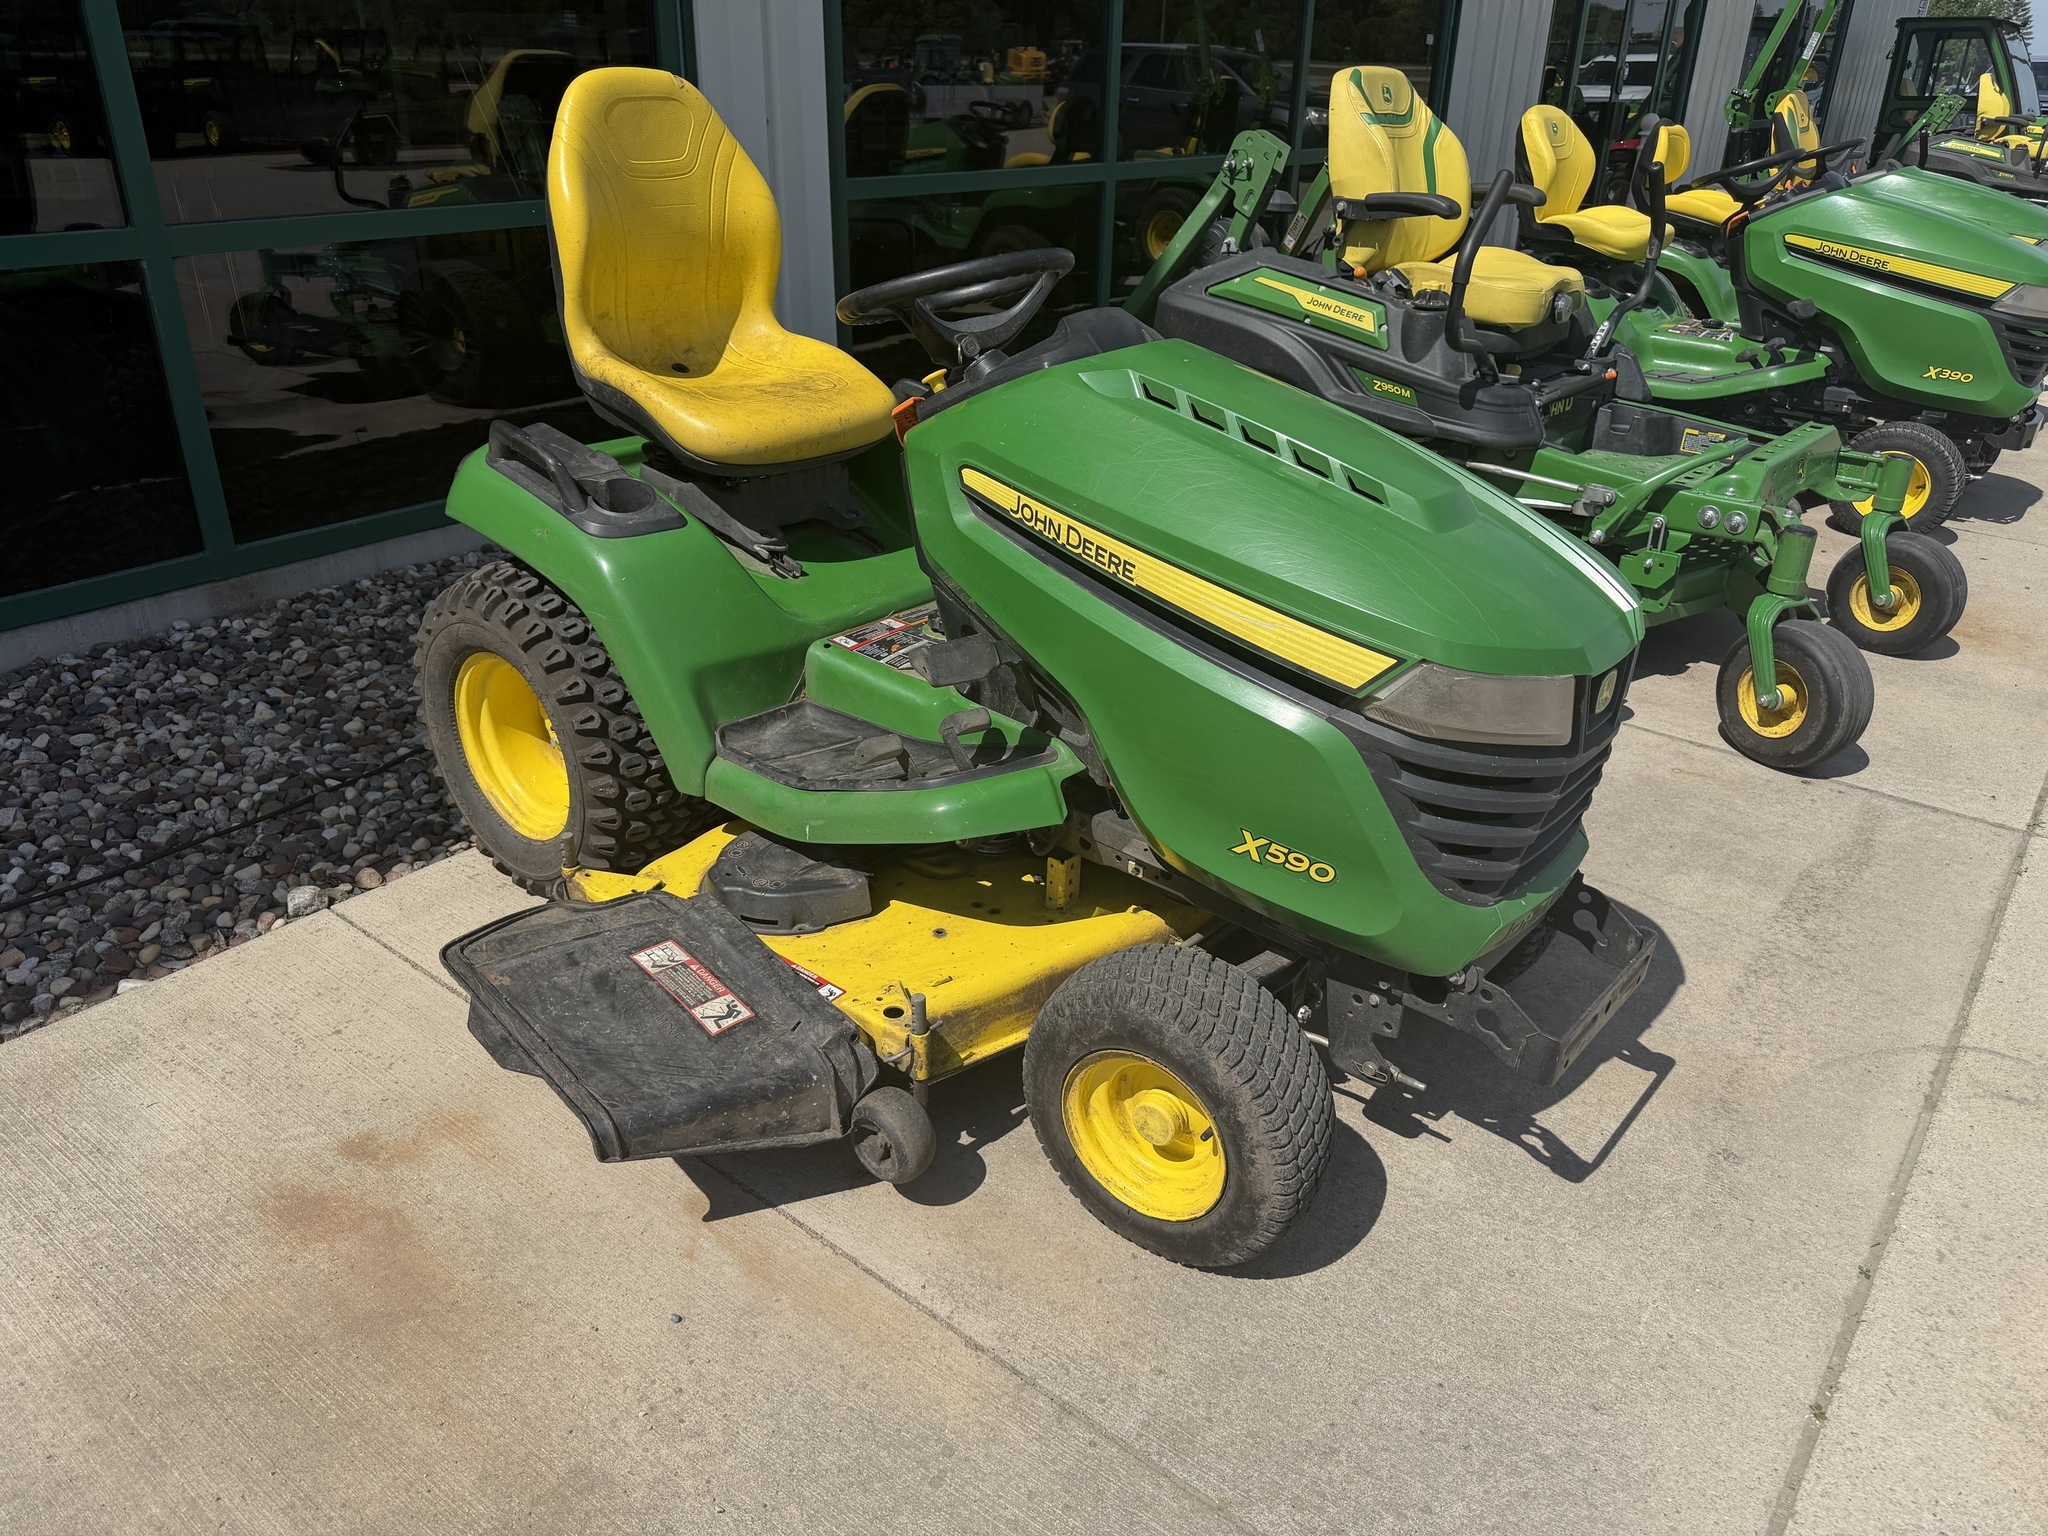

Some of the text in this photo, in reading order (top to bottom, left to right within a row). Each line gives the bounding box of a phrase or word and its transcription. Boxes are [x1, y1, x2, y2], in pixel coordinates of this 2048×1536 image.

[1815, 242, 1890, 269] JOHN DEERE
[1307, 297, 1365, 322] JOHN DEERE
[1920, 365, 1974, 383] X390
[1372, 379, 1411, 398] Z950M
[1009, 495, 1136, 582] JOHN DEERE
[1227, 827, 1337, 883] X590
[697, 968, 726, 993] DANGER
